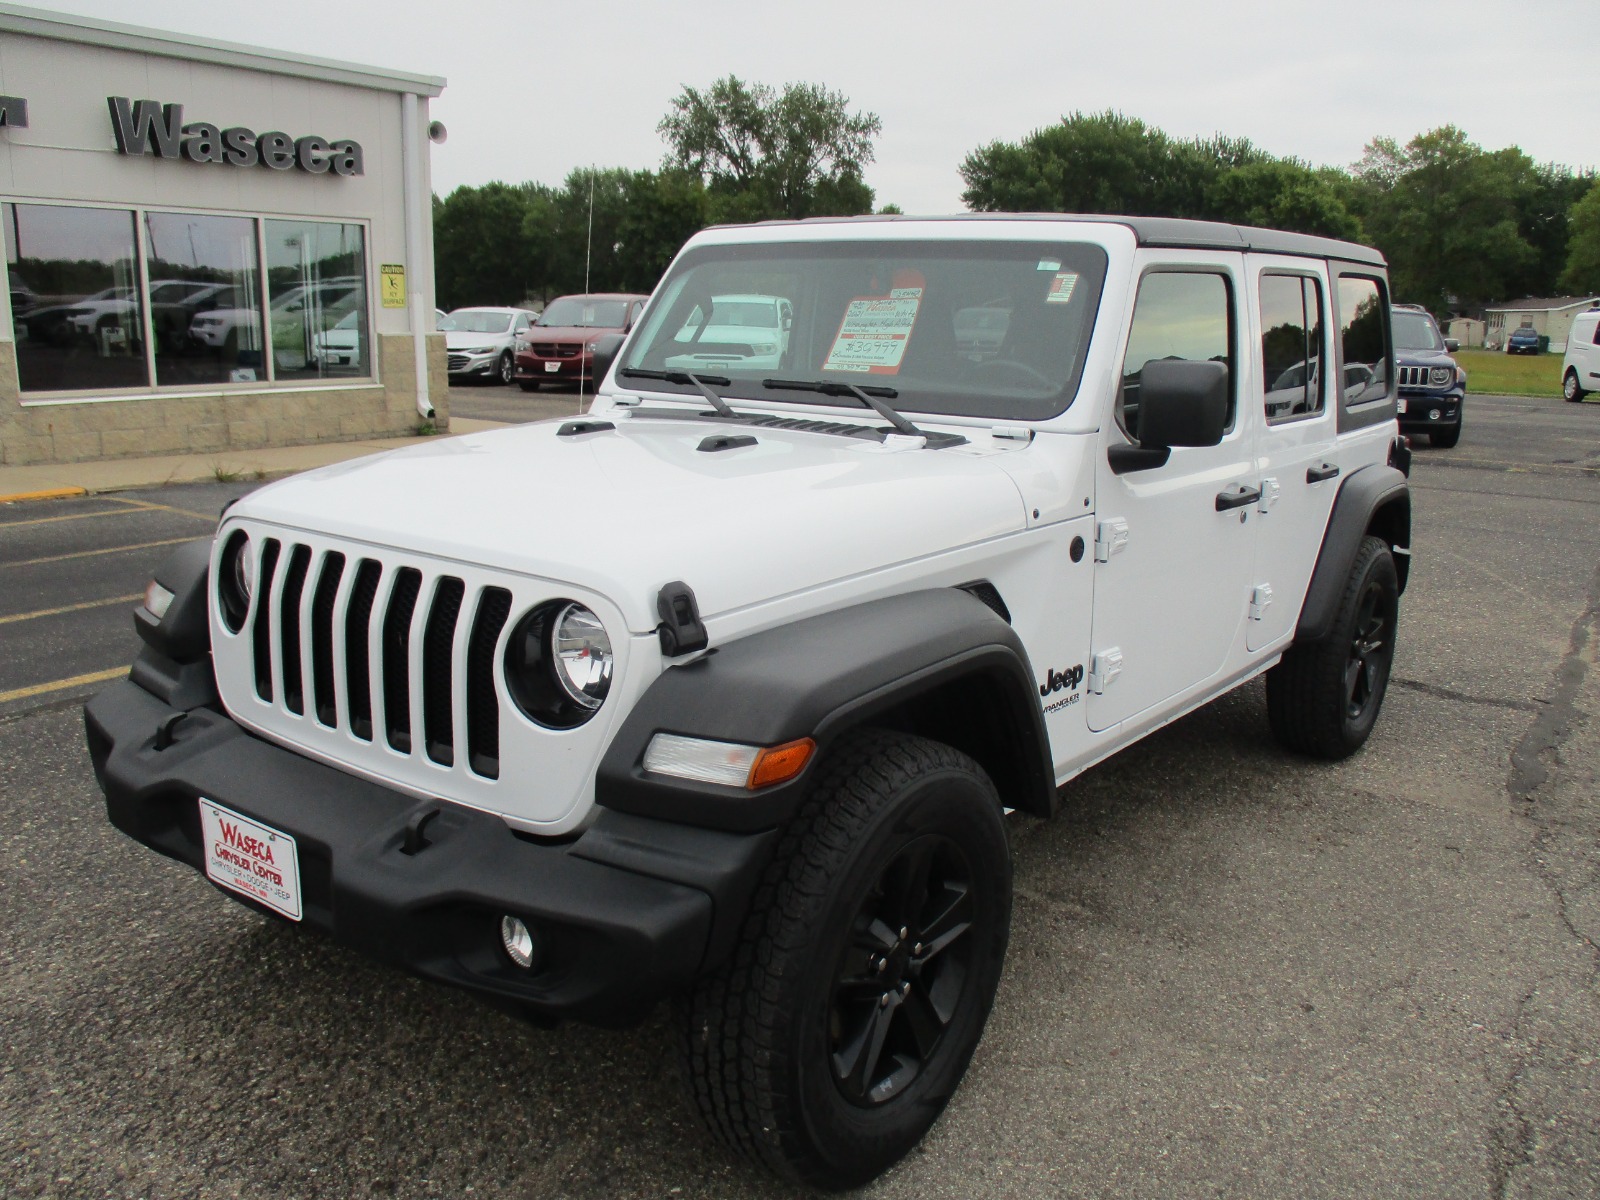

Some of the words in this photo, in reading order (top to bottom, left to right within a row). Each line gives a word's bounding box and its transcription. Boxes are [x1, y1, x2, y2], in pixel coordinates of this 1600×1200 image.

[107, 96, 365, 177] Waseca
[1040, 664, 1083, 696] Jeep
[219, 818, 275, 865] WASECA
[212, 858, 242, 876] CHRYSLER
[247, 875, 269, 891] DODGE
[274, 888, 290, 900] JEEP
[215, 843, 251, 872] CHRYSLER
[253, 861, 283, 887] CENTER
